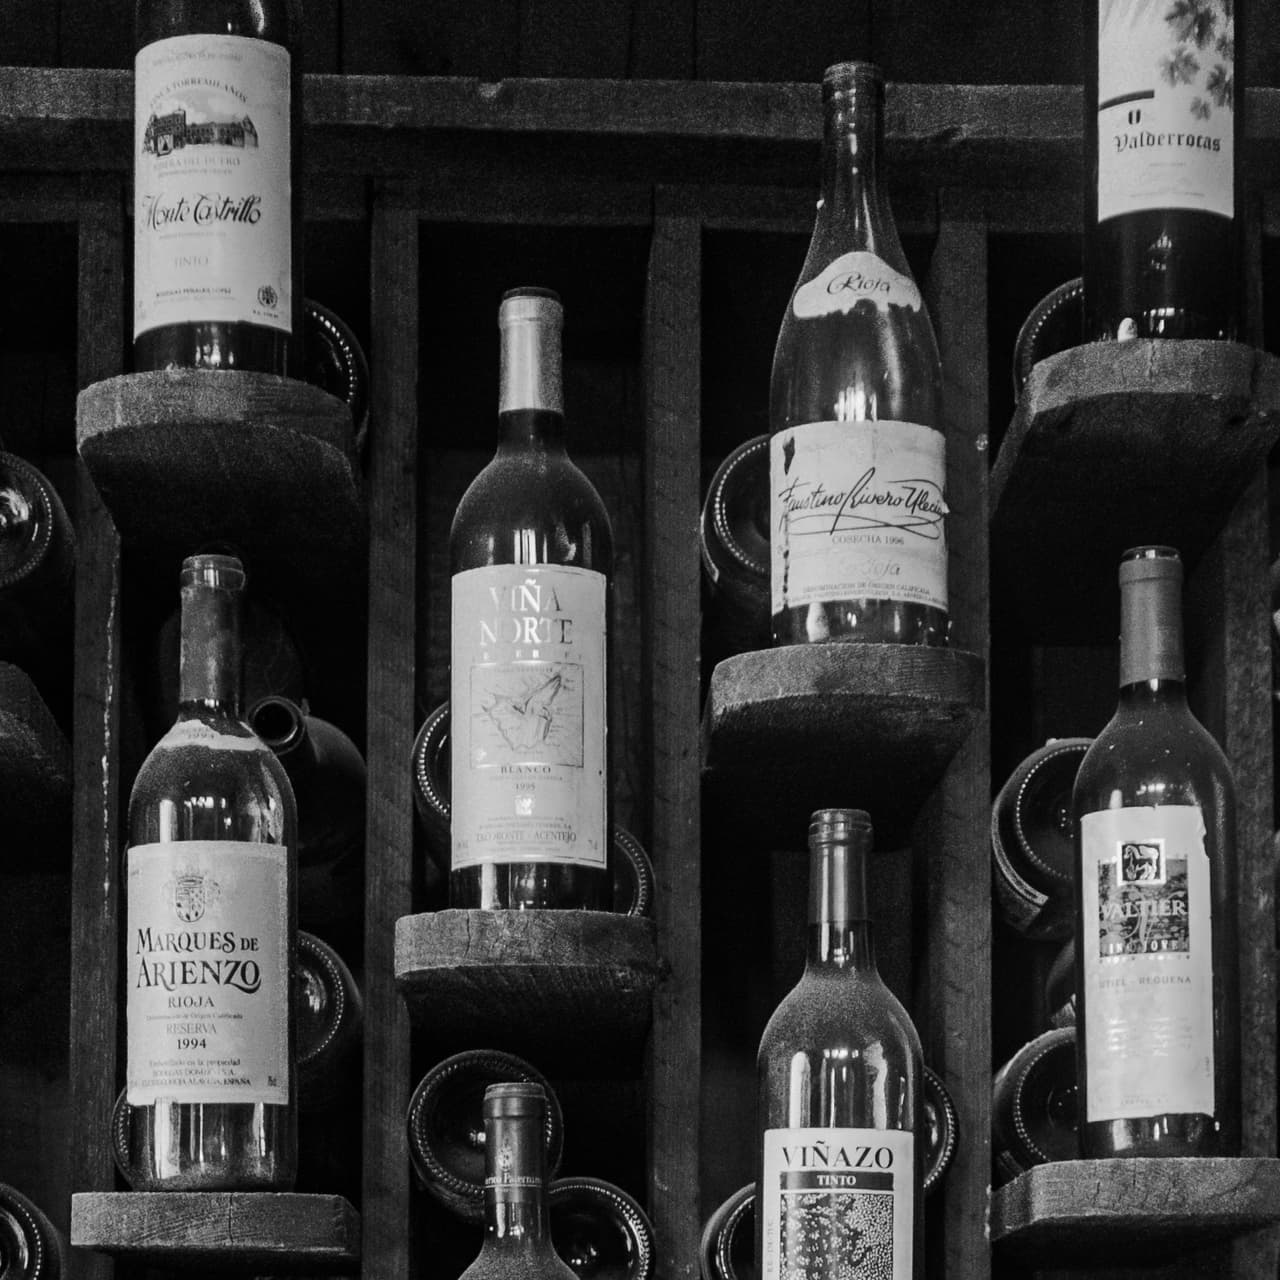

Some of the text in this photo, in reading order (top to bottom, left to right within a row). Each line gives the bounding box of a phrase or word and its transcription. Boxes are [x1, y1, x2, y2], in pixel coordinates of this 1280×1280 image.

[479, 616, 574, 648] NORTE
[1100, 897, 1188, 919] VALTIER
[135, 927, 259, 954] MARQUES DE
[136, 957, 262, 994] ARIENZO
[167, 996, 216, 1008] RIOJA
[176, 1037, 208, 1051] 1994
[780, 1140, 895, 1170] VIÑAZO
[816, 1174, 857, 1186] TINTO
